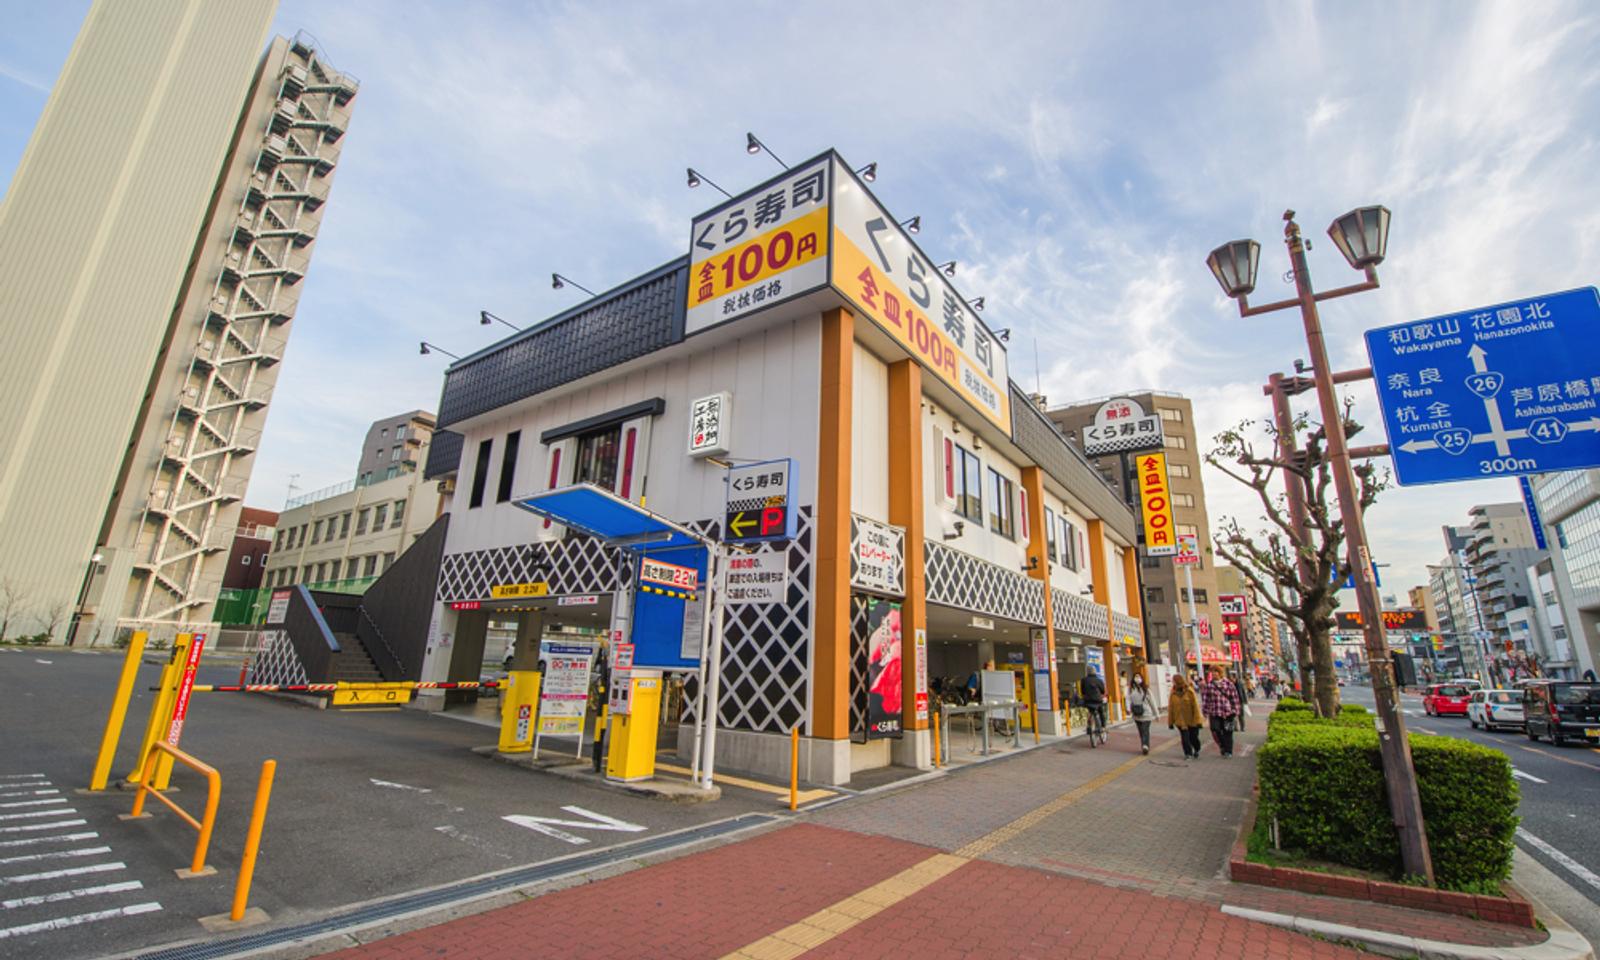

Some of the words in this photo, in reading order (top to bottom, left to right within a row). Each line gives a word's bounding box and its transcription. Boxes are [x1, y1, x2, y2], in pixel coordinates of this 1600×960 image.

[696, 168, 825, 250] くら寿司
[865, 217, 994, 378] くら寿司
[1388, 319, 1460, 345] 和歌山
[1470, 303, 1550, 330] 花園北
[1393, 337, 1462, 355] Wakayama
[1474, 320, 1554, 342] Hanazonokita
[1387, 368, 1443, 390] 奈良
[1474, 377, 1496, 392] 26
[1403, 388, 1433, 398] Nara
[1396, 401, 1451, 423] 杭全
[1515, 398, 1596, 418] Ashiharabashi
[1088, 420, 1155, 440] くら寿司
[1401, 419, 1452, 434] Kumata
[1536, 421, 1560, 438] 41
[1443, 432, 1465, 447] 25
[1480, 458, 1537, 474] 300m
[733, 472, 784, 491] くら寿司
[761, 507, 784, 536] P
